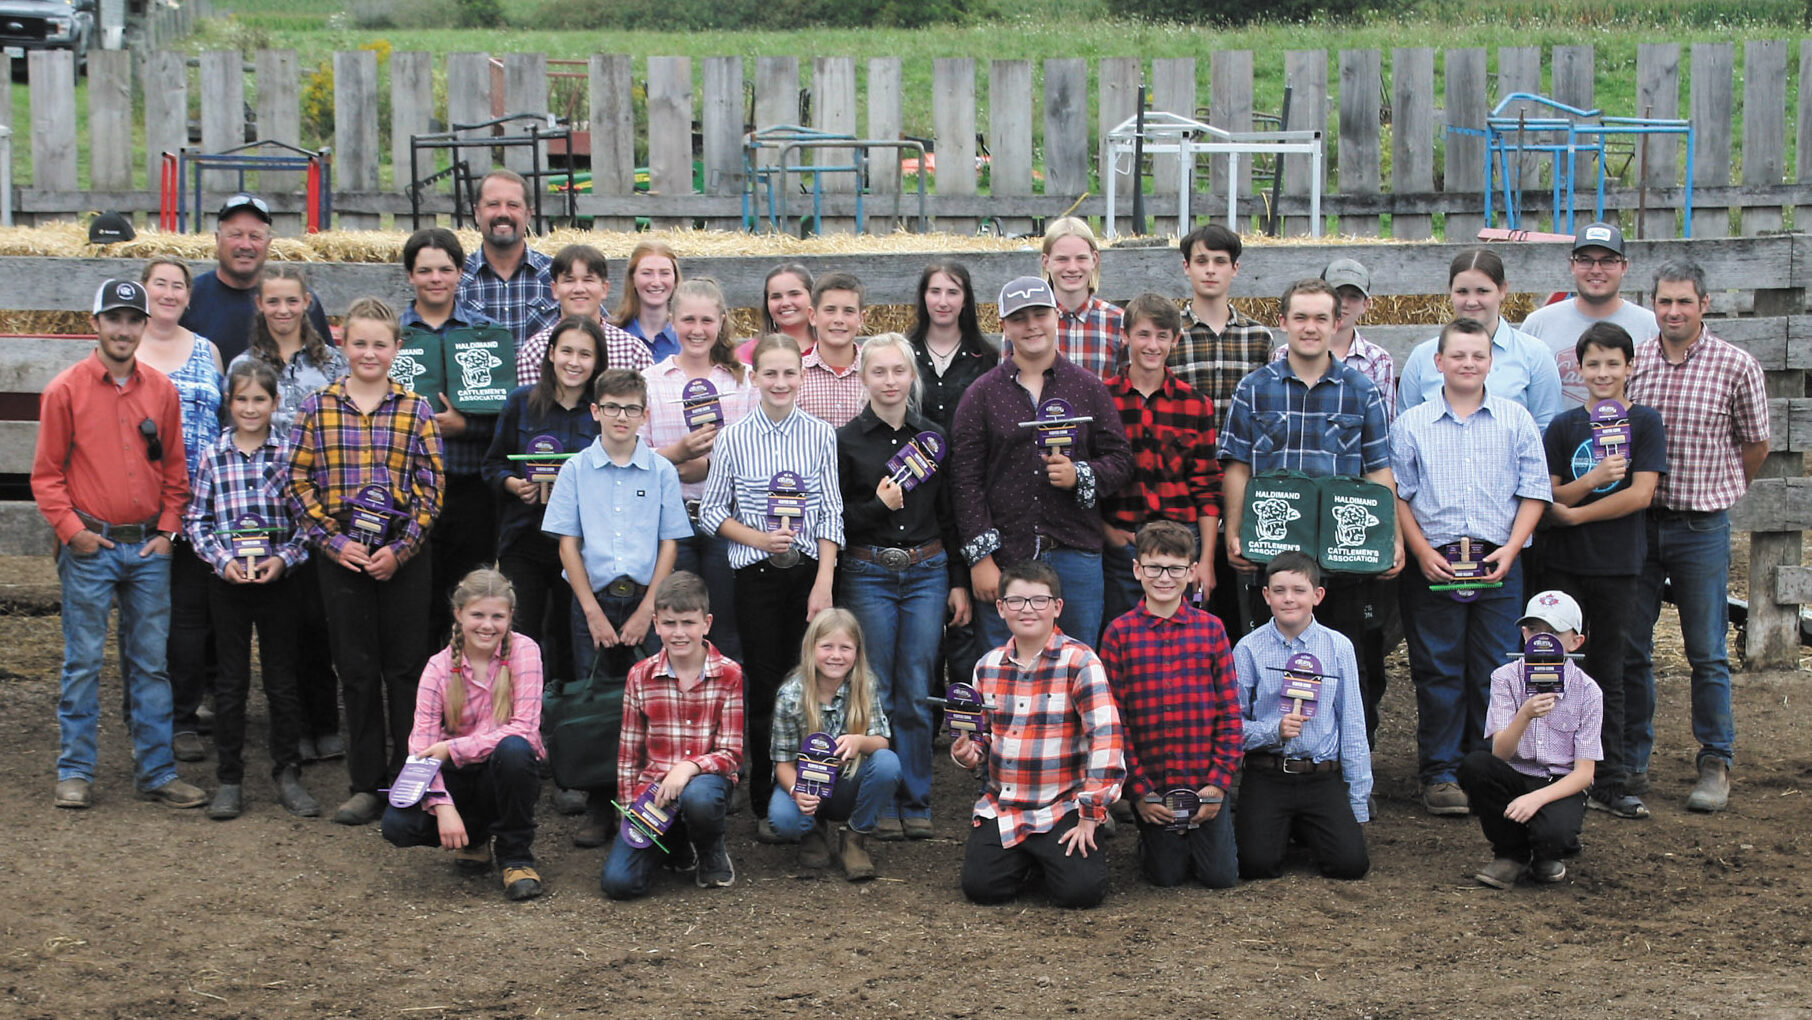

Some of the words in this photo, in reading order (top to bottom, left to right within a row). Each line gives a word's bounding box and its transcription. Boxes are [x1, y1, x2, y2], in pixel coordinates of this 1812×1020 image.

[455, 341, 498, 349] HALDIMAND
[457, 388, 507, 396] CATTLEMEN'S
[459, 394, 507, 402] ASSOCIATION
[1255, 490, 1300, 500] HALDIMAND
[1334, 496, 1378, 506] HALDIMAND
[1248, 541, 1301, 551] CATTLEMEN'S
[1327, 547, 1380, 556] CATTLEMEN'S
[1327, 554, 1379, 563] ASSOCIATION
